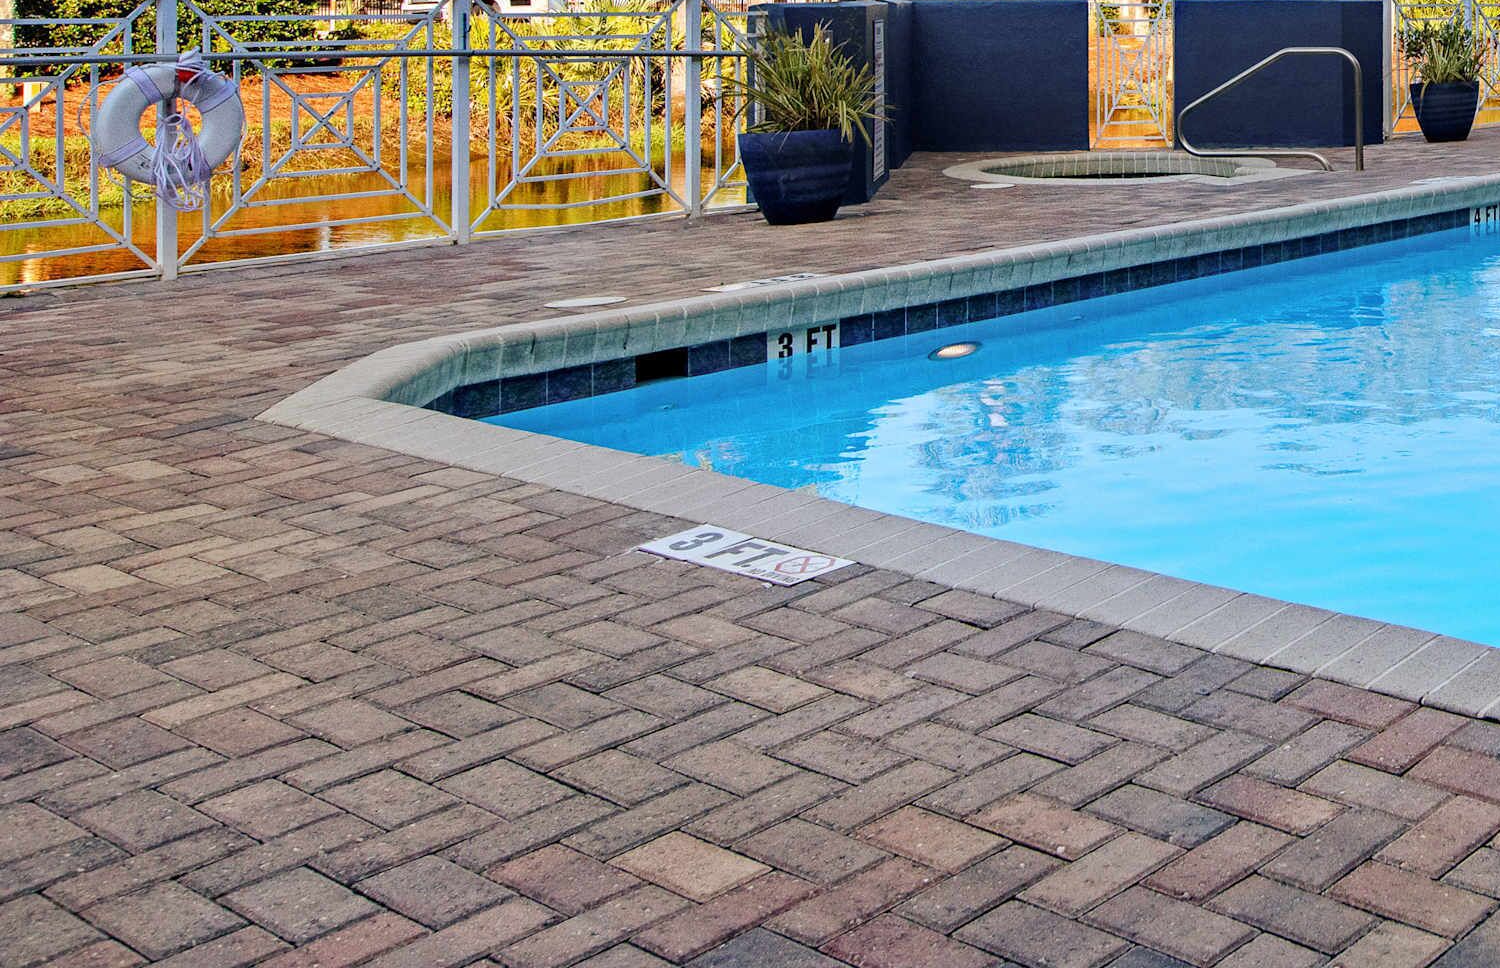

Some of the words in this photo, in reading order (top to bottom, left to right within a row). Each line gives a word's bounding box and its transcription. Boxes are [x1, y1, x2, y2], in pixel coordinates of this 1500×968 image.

[1473, 207, 1481, 224] 4
[1486, 204, 1498, 223] FT
[778, 332, 793, 358] 3
[806, 323, 837, 353] FT
[669, 532, 724, 551] 3
